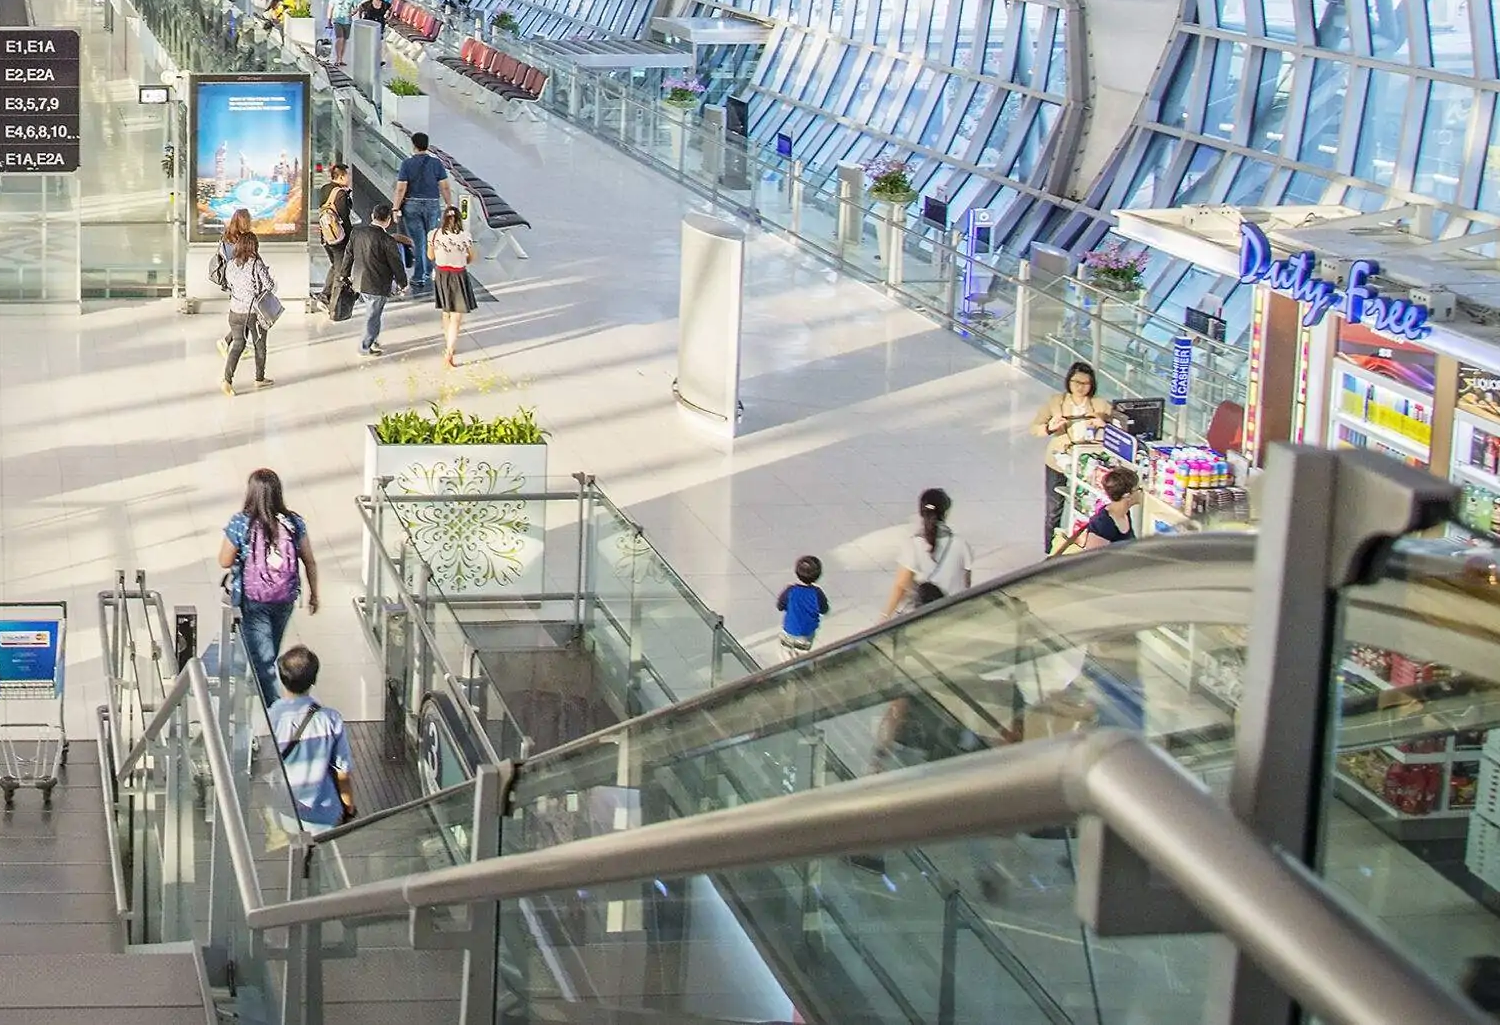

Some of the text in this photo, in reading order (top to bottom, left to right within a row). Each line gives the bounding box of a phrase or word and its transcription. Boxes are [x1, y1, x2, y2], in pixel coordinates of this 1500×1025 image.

[5, 40, 56, 54] E1,E1A
[5, 68, 55, 82] E2,E2A
[5, 97, 59, 111] E3,5,7,9
[5, 153, 65, 166] E1A,E2A
[1239, 222, 1431, 340] Duty Free
[1177, 349, 1190, 394] CASHIER
